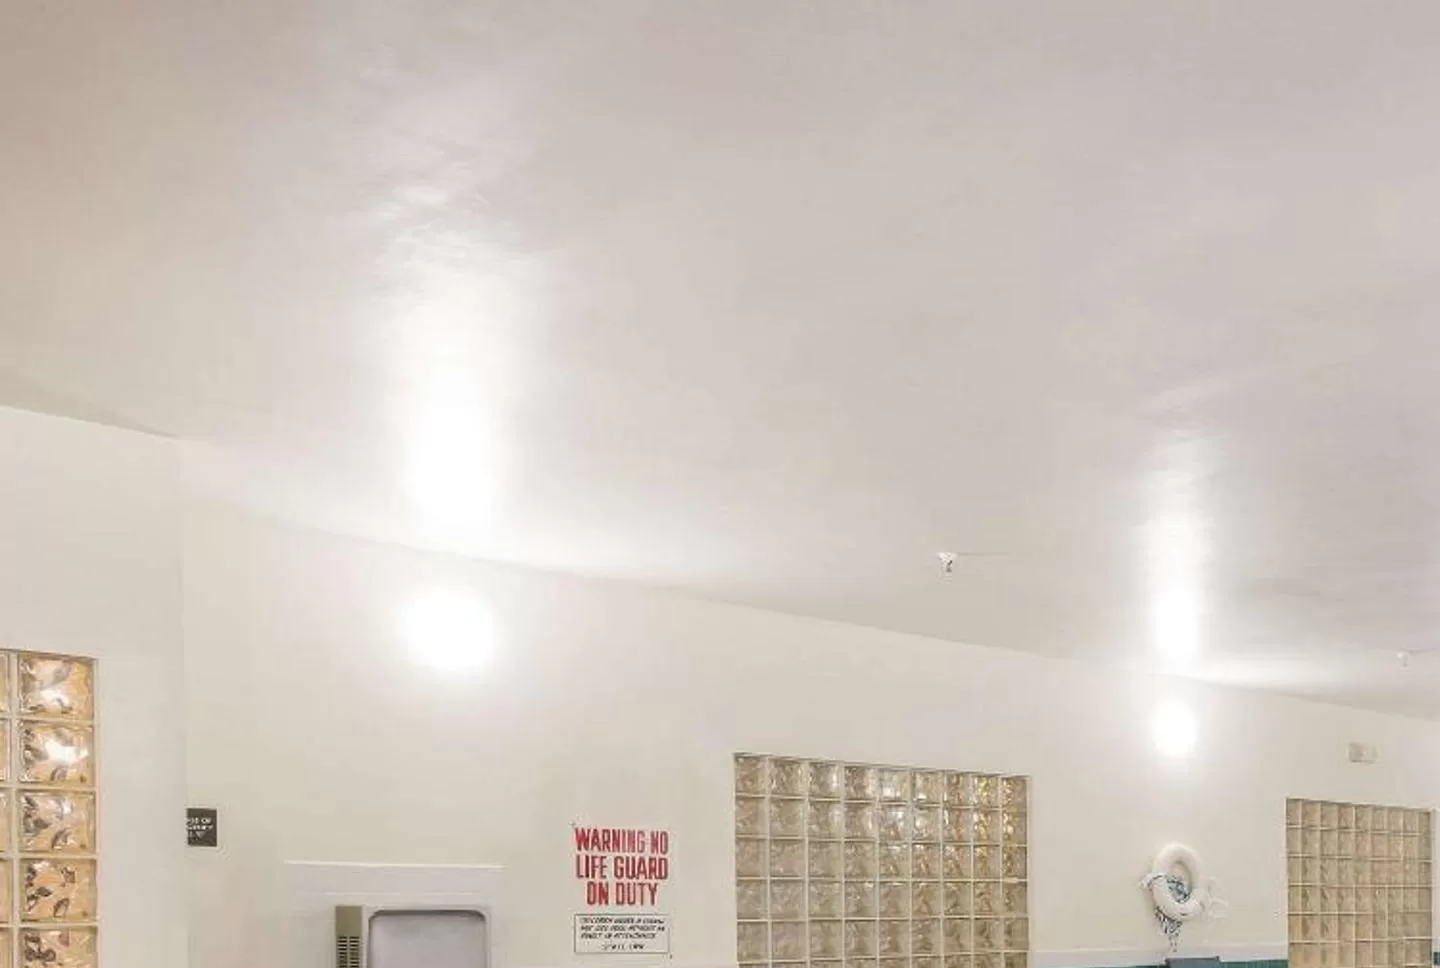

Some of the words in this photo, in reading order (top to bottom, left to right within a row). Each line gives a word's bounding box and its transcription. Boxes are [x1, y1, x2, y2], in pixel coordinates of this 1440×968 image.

[574, 827, 645, 853] WARNING
[650, 830, 669, 855] NO
[576, 854, 607, 879] LIFE
[614, 855, 668, 880] GUARD
[586, 881, 609, 906] ON
[615, 883, 659, 906] DUTY
